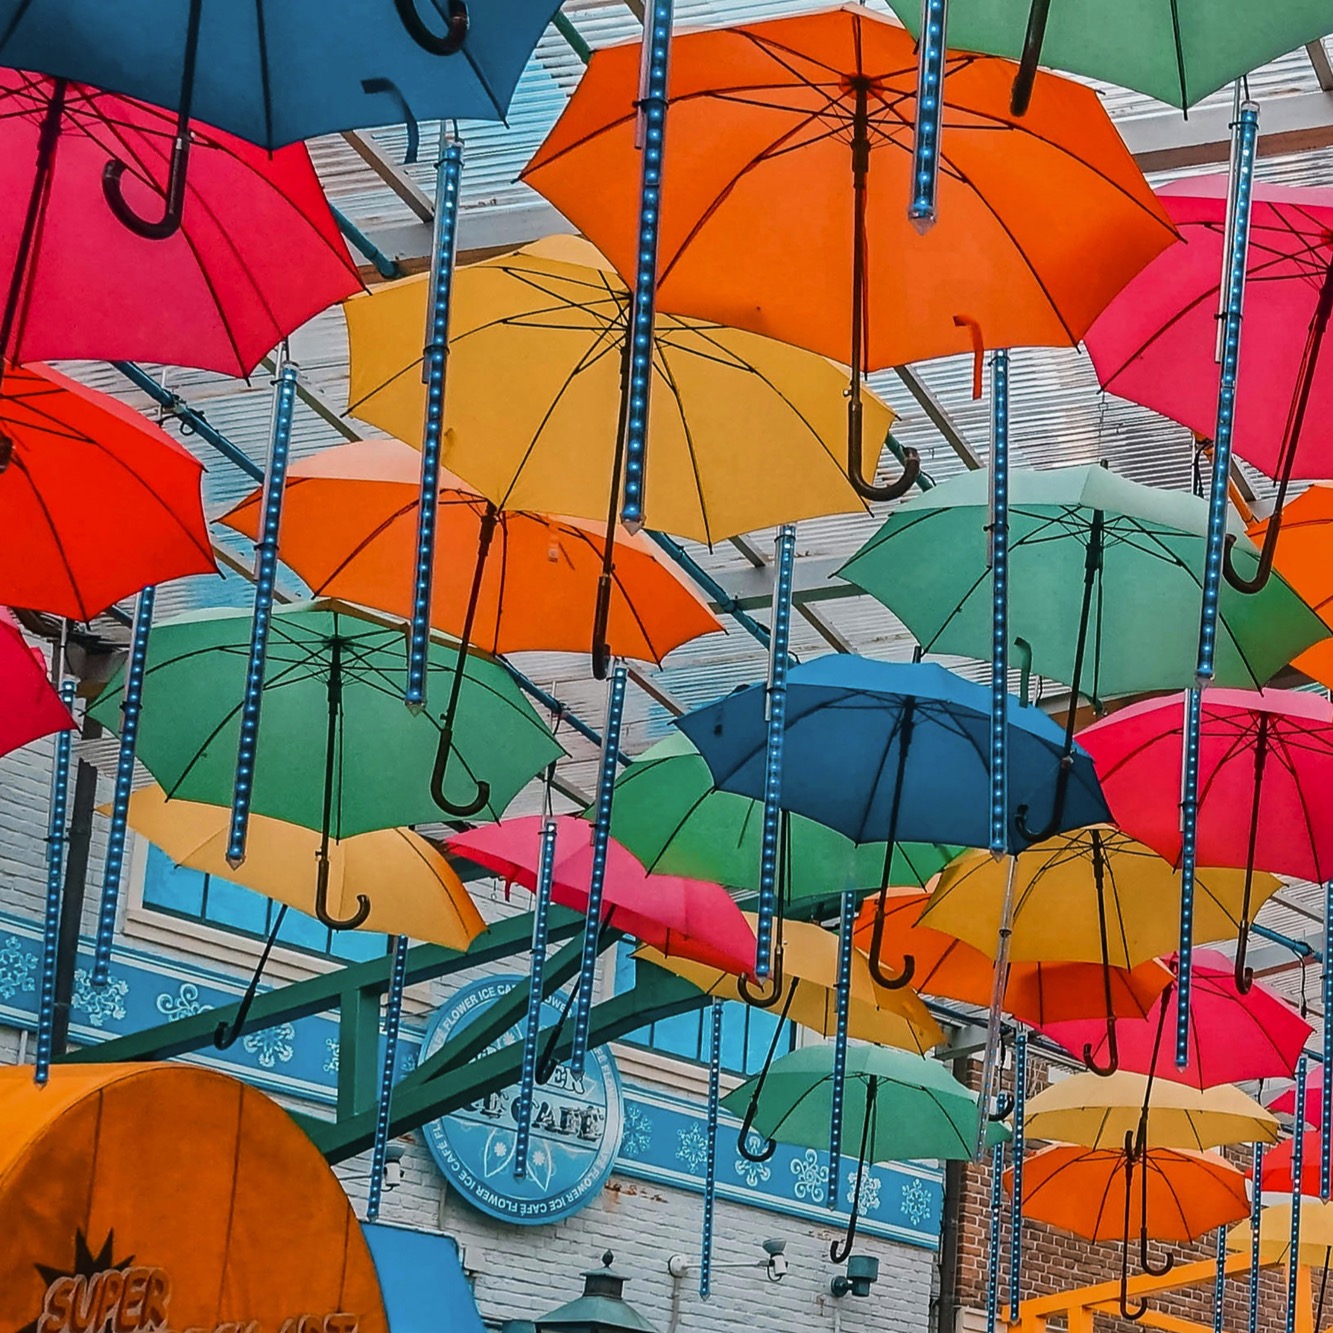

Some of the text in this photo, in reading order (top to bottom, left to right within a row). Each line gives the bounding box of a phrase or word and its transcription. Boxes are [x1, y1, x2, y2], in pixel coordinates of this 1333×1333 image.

[443, 993, 480, 1033] FLOWER
[478, 986, 496, 1001] ICE
[436, 1139, 601, 1217] FLOWER ICE CAFÉ FLOWER ICE CAFÉ
